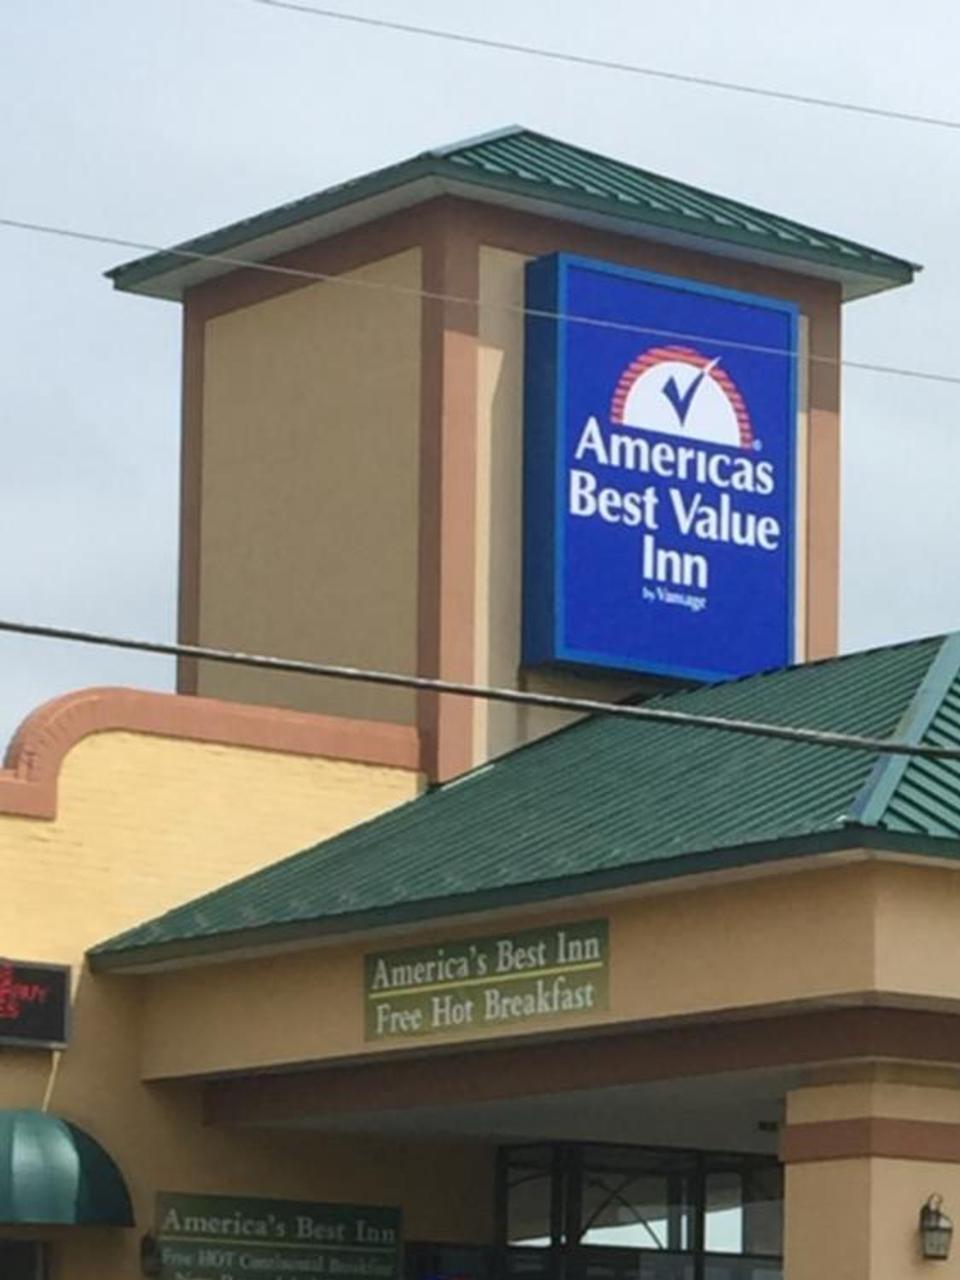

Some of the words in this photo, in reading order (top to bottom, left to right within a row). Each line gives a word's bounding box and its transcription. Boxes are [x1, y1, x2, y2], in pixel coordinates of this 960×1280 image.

[575, 416, 775, 495] Americas
[569, 469, 658, 530] Best
[669, 487, 781, 550] Value
[642, 534, 708, 589] Inn
[371, 945, 488, 990] America's
[496, 940, 547, 973] Best
[557, 931, 600, 964] Inn
[375, 1003, 423, 1035] Free
[431, 994, 474, 1027] Hot
[484, 976, 595, 1021] Breakfast
[162, 1207, 286, 1238] America's
[296, 1215, 346, 1242] Best
[355, 1219, 396, 1245] Inn
